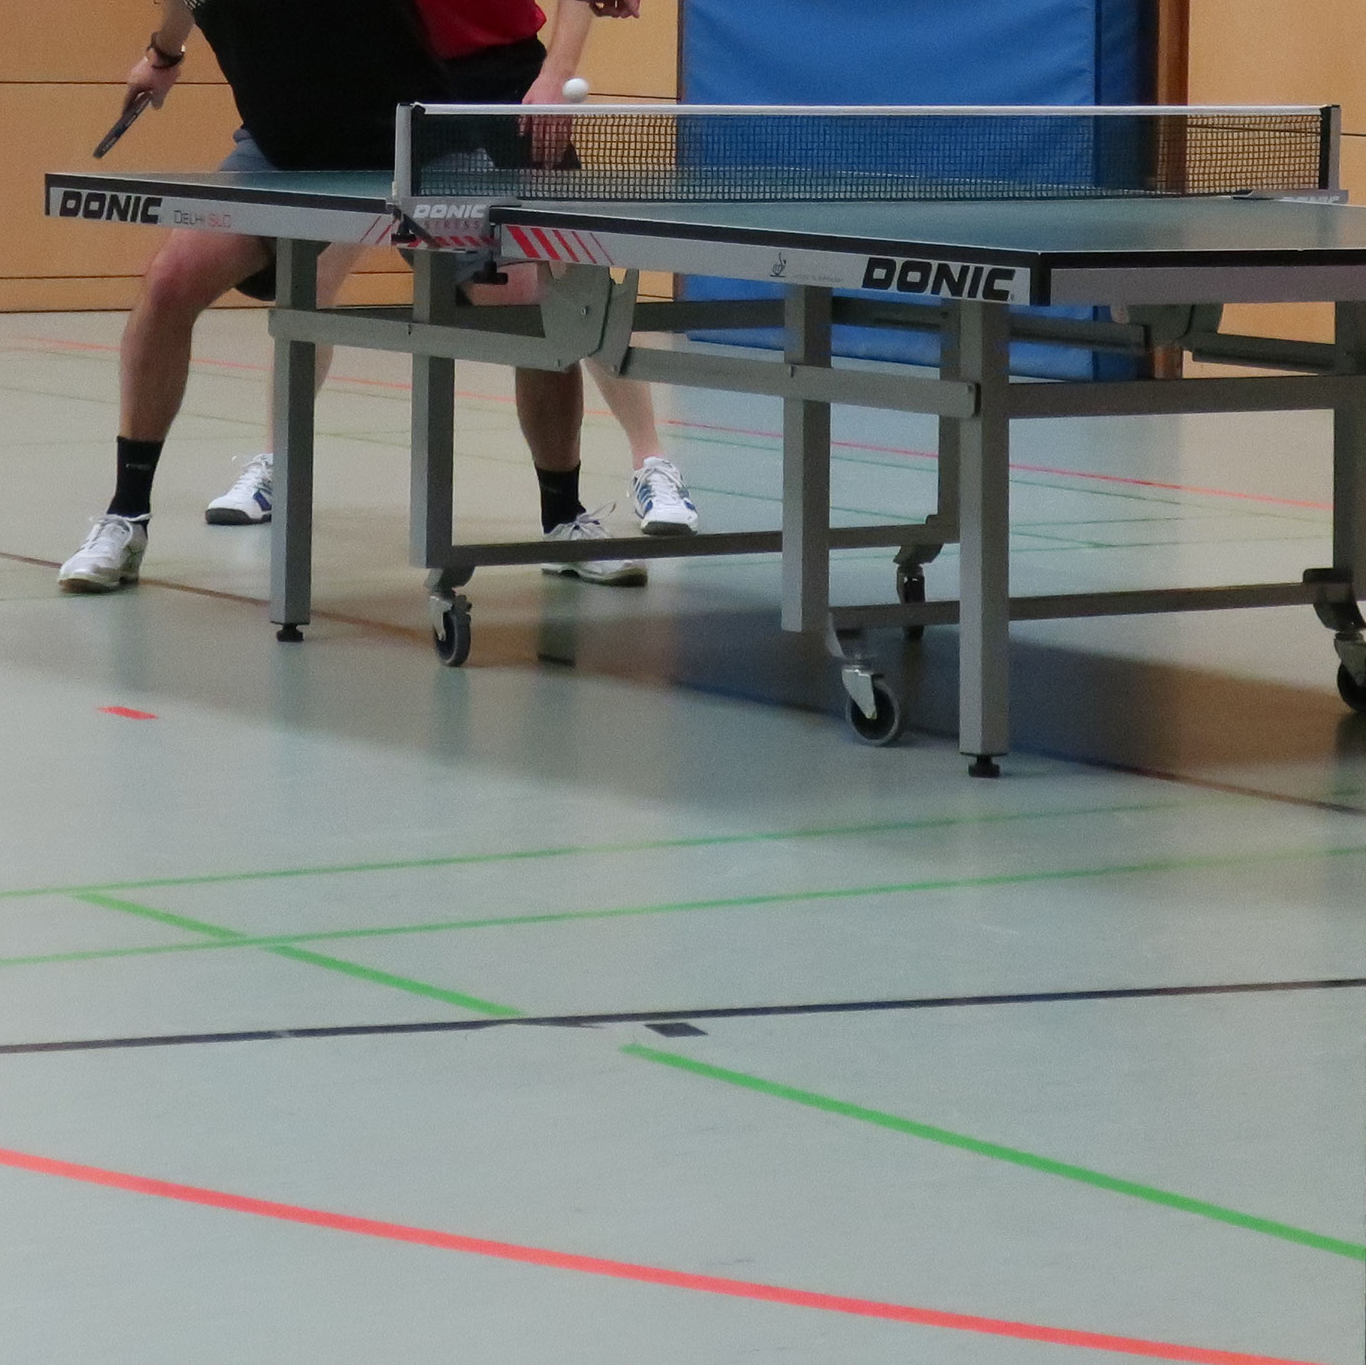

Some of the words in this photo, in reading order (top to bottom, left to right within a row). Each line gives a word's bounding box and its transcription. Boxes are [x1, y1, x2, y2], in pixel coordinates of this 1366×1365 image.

[59, 189, 163, 225] DONIC
[413, 203, 488, 220] DONIC
[862, 256, 1016, 302] DONIC
